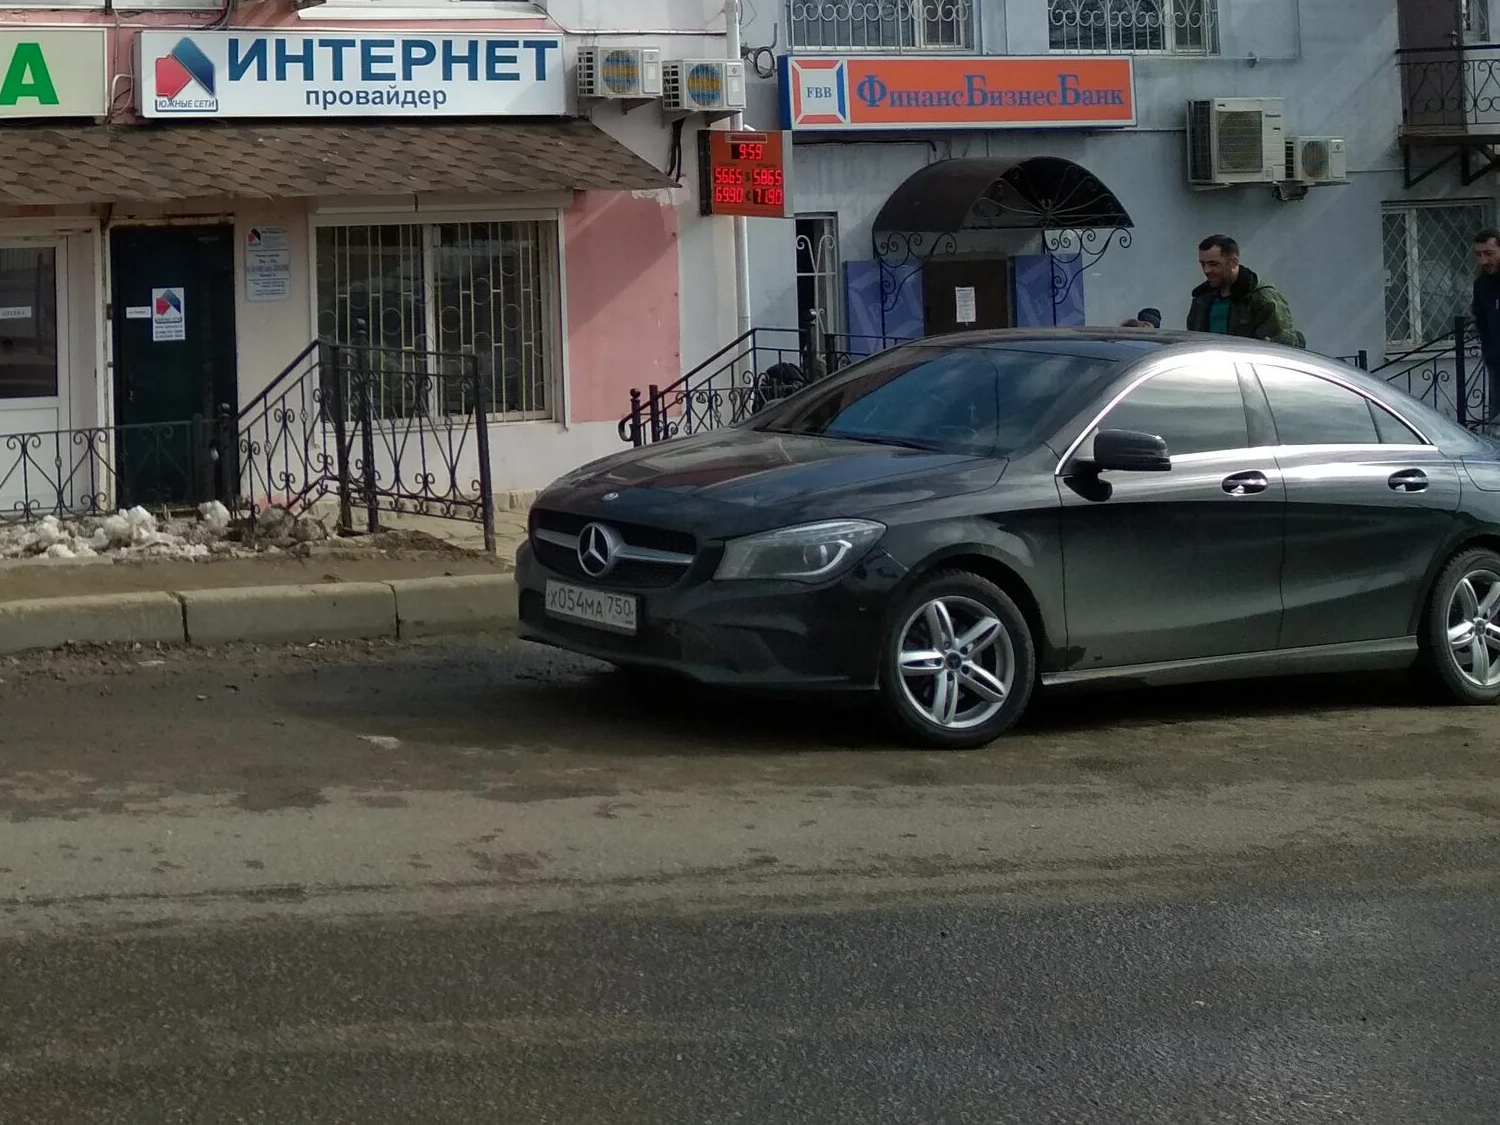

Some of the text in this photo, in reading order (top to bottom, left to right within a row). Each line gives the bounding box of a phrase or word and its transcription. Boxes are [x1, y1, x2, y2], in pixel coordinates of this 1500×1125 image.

[227, 37, 559, 82] ИНТЕРНЕТ
[158, 99, 215, 108] ЮЖНЫЕ СЕТИ
[304, 84, 447, 111] провайдер
[806, 86, 833, 99] FBB
[856, 74, 1125, 108] ФинансБизнесБанк
